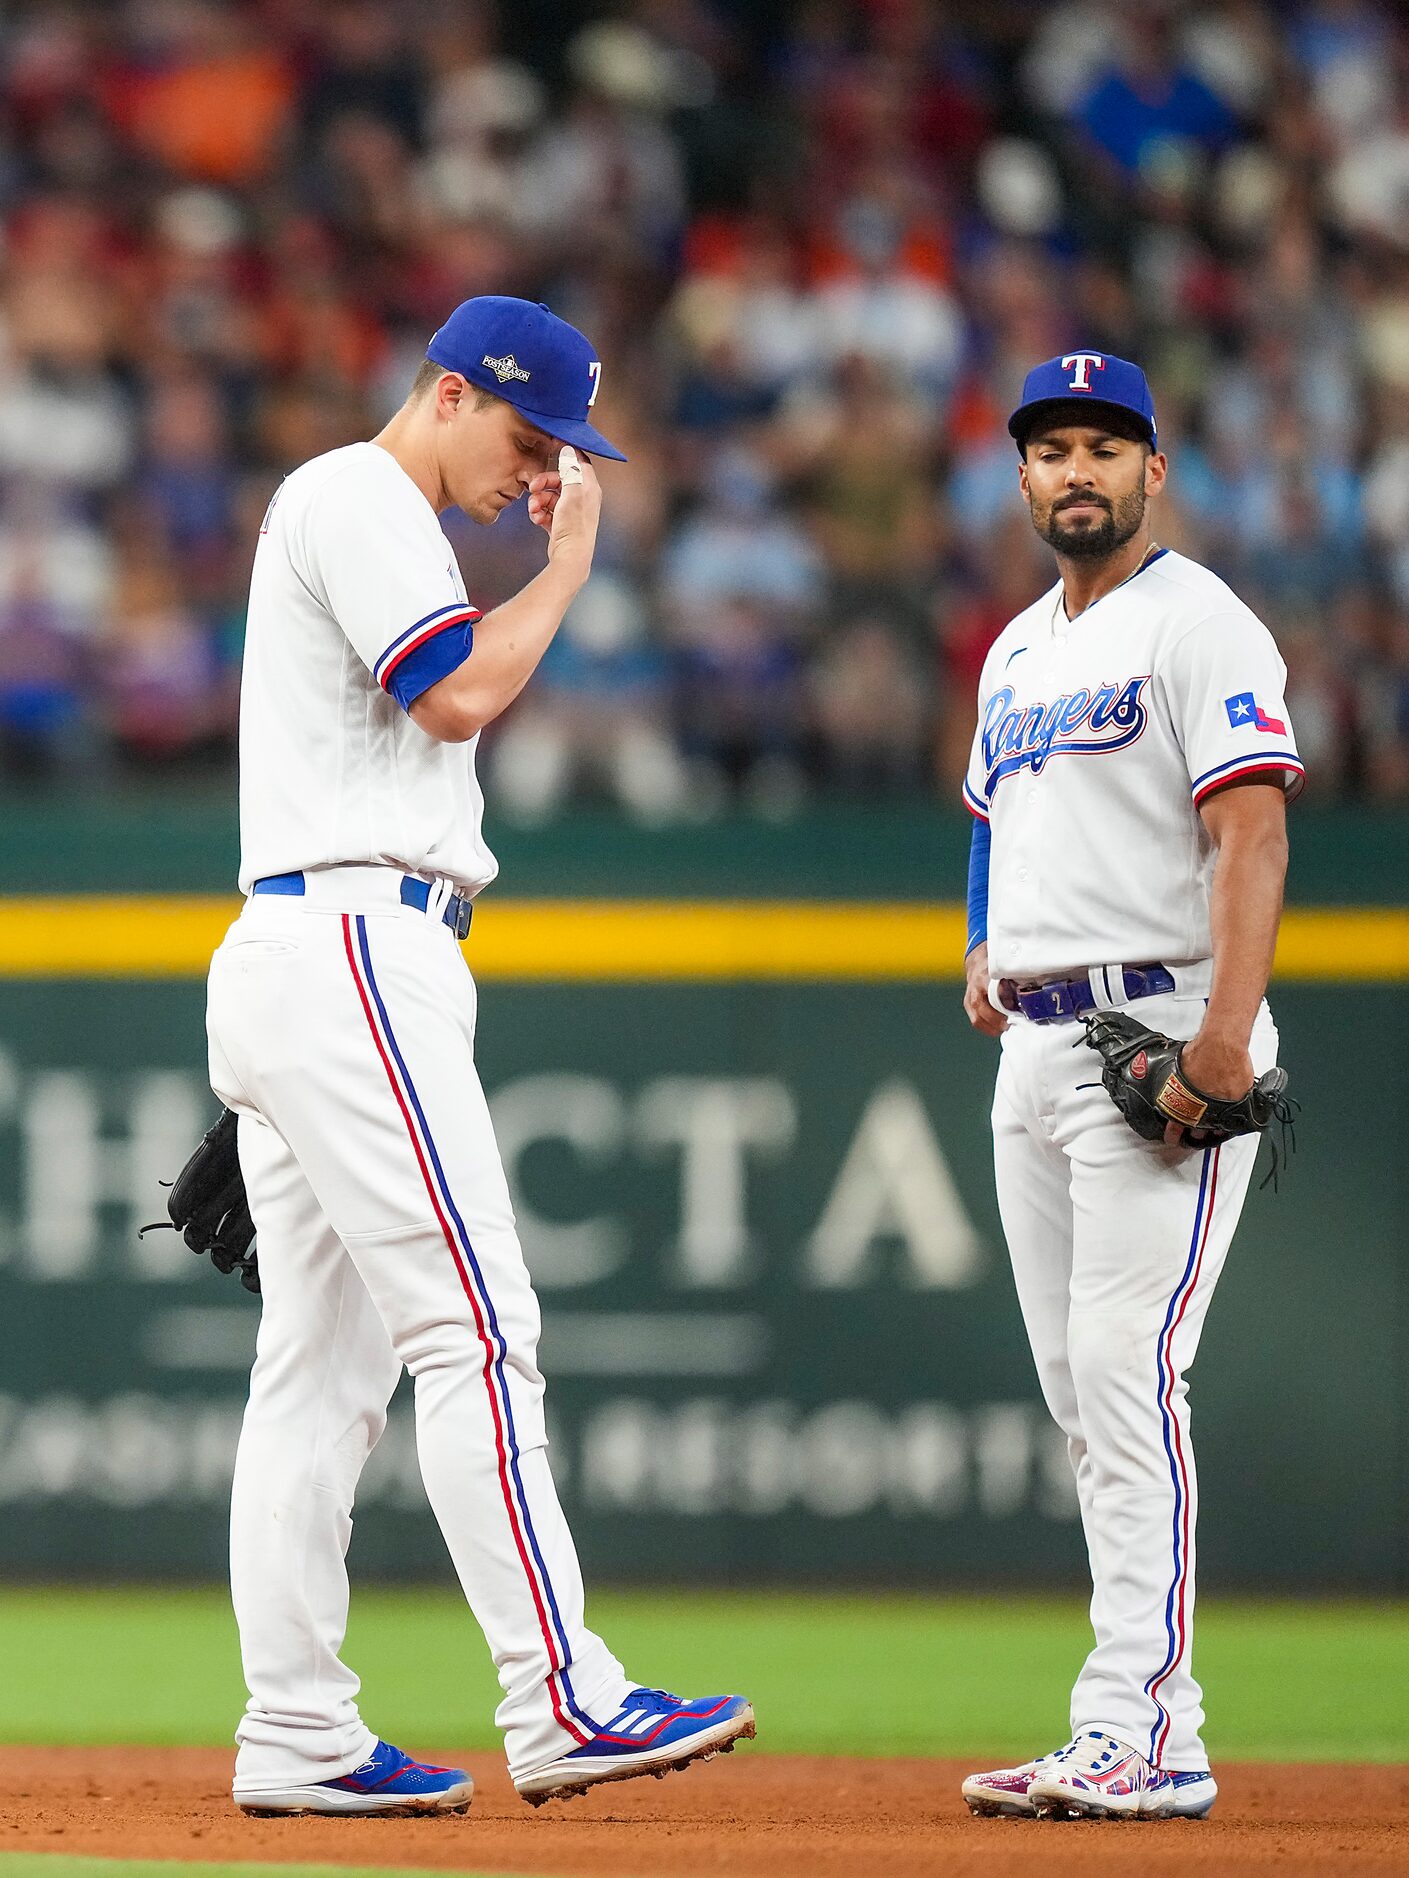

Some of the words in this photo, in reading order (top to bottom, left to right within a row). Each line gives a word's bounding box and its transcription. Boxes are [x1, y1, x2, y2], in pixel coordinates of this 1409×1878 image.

[483, 356, 530, 382] POSTSEASON
[1061, 355, 1105, 393] T
[981, 675, 1151, 777] Rangers
[1052, 992, 1064, 1015] 2
